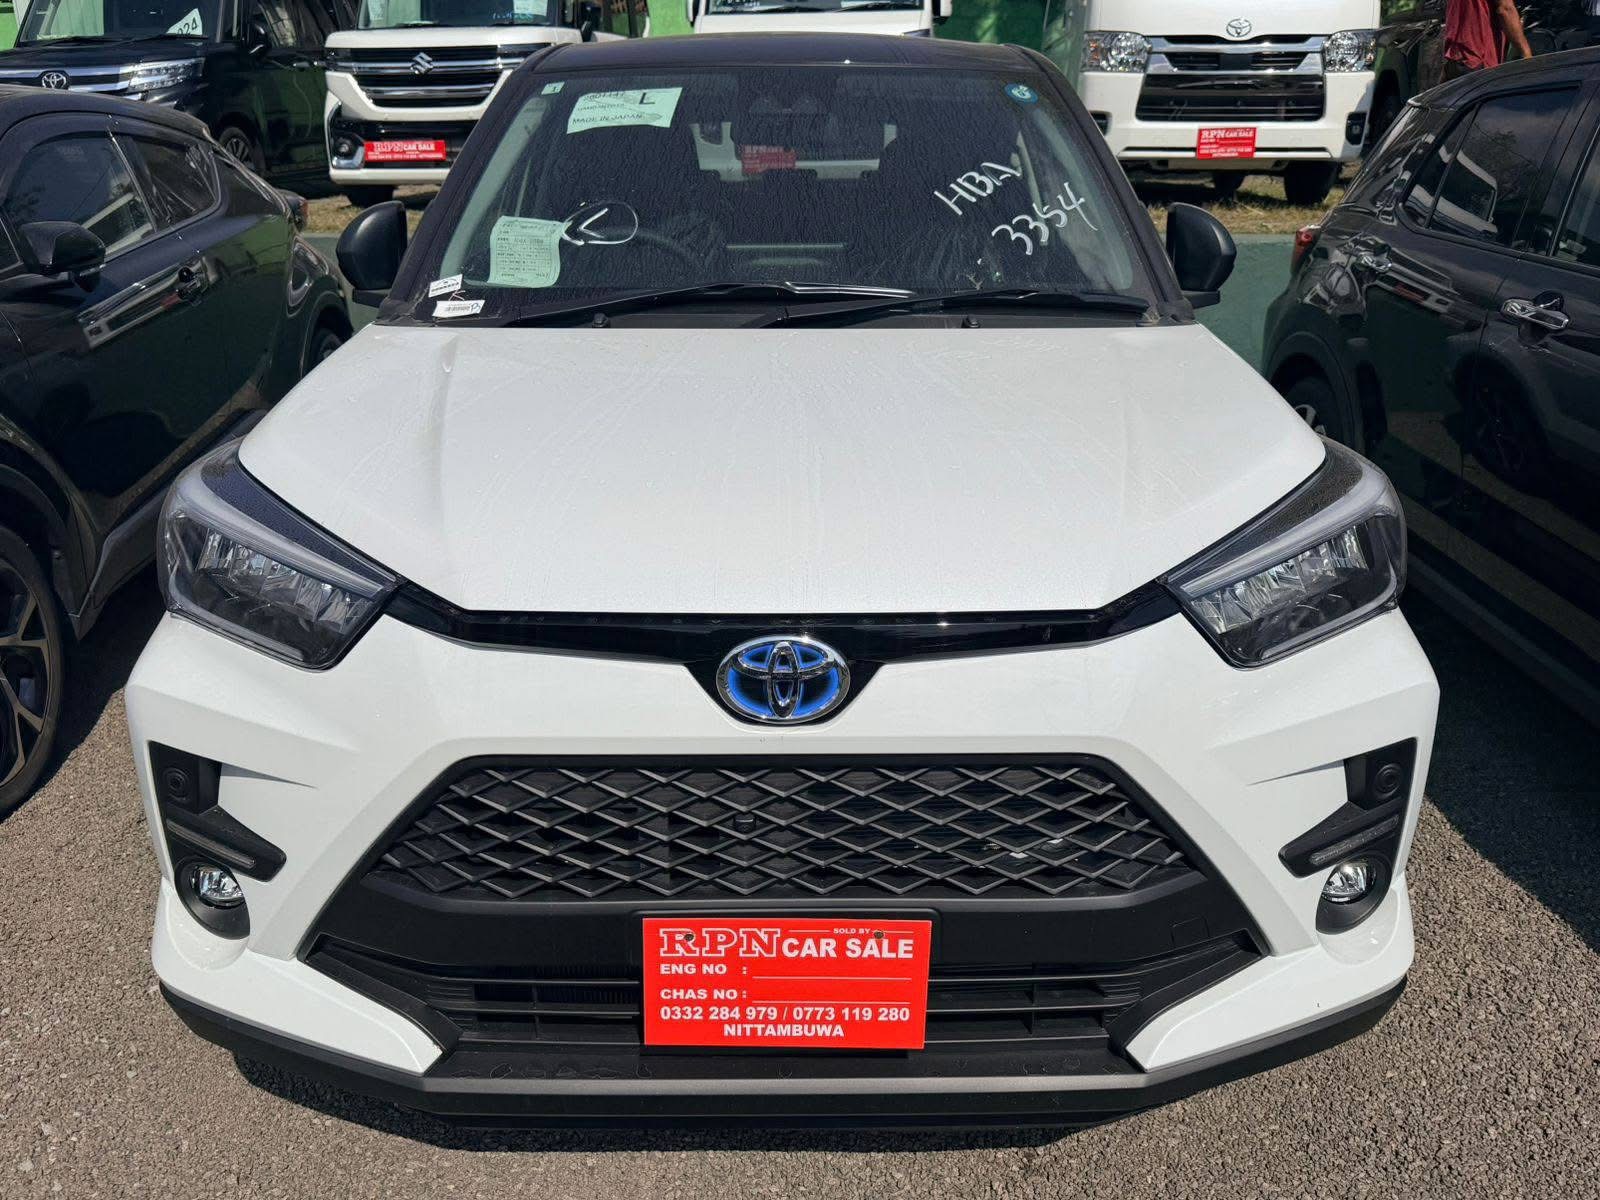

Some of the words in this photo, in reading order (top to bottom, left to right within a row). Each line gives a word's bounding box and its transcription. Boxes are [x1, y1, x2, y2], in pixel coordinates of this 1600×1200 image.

[638, 92, 656, 105] L
[659, 928, 780, 957] RPN
[781, 938, 837, 958] CAR
[845, 939, 914, 958] SALE
[660, 964, 697, 975] ENG
[702, 964, 727, 975] NO
[660, 989, 707, 1000] CHAS
[713, 989, 738, 1000] NO
[660, 1006, 703, 1020] 0332
[709, 1006, 740, 1020] 284
[746, 1006, 777, 1021] 979
[782, 1006, 789, 1021] /
[792, 1007, 836, 1021] 0773
[841, 1007, 872, 1021] 119
[877, 1007, 910, 1021] 280
[723, 1024, 845, 1037] NITTAMBUWA
